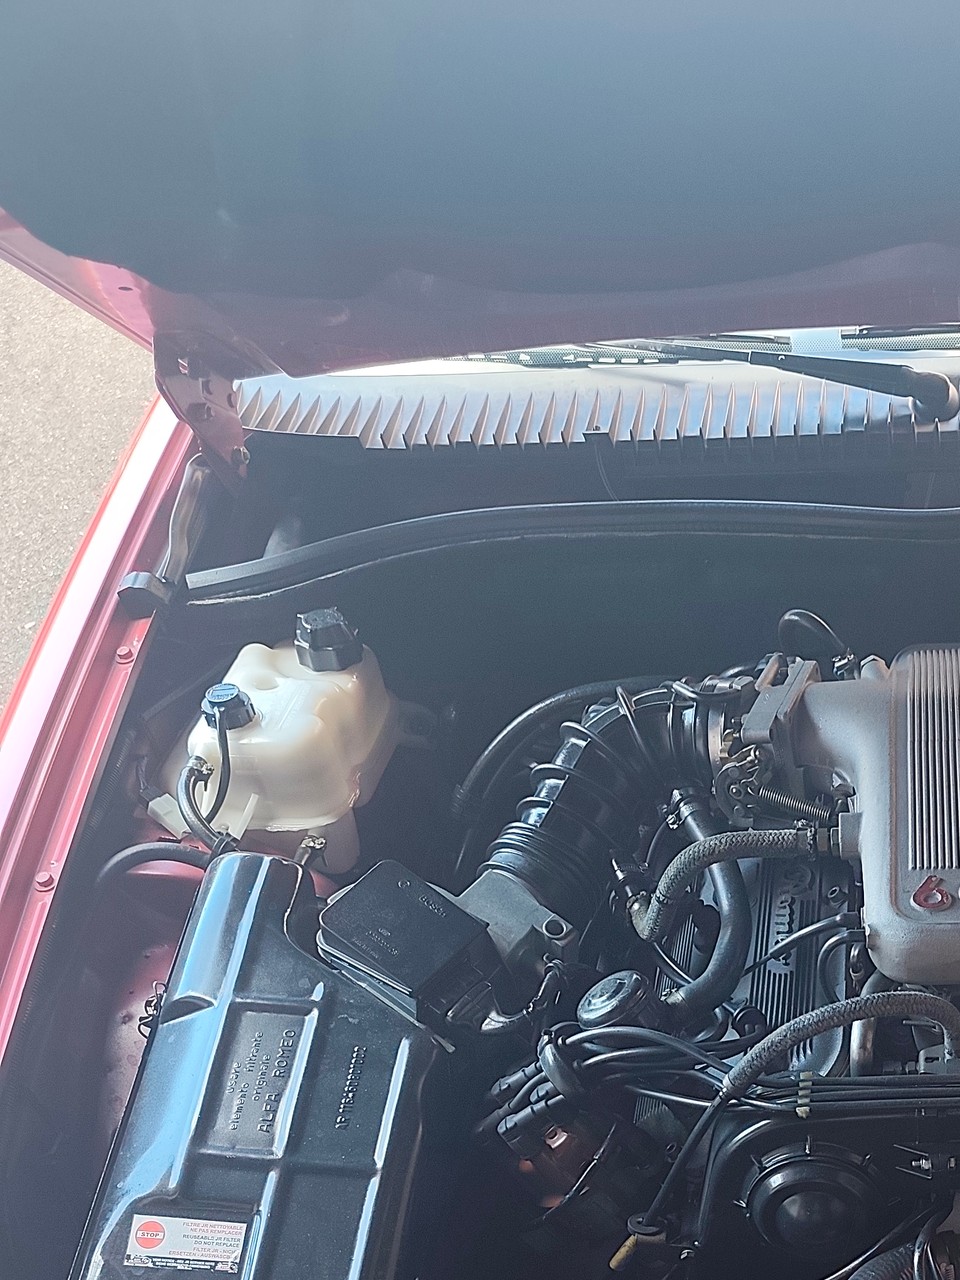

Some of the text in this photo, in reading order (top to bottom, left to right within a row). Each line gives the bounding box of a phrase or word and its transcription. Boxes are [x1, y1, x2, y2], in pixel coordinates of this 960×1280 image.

[226, 1061, 242, 1094] usare
[229, 1031, 264, 1131] elemento filtrante
[252, 1054, 271, 1101] originale
[257, 1029, 296, 1134] ALFA ROMEO
